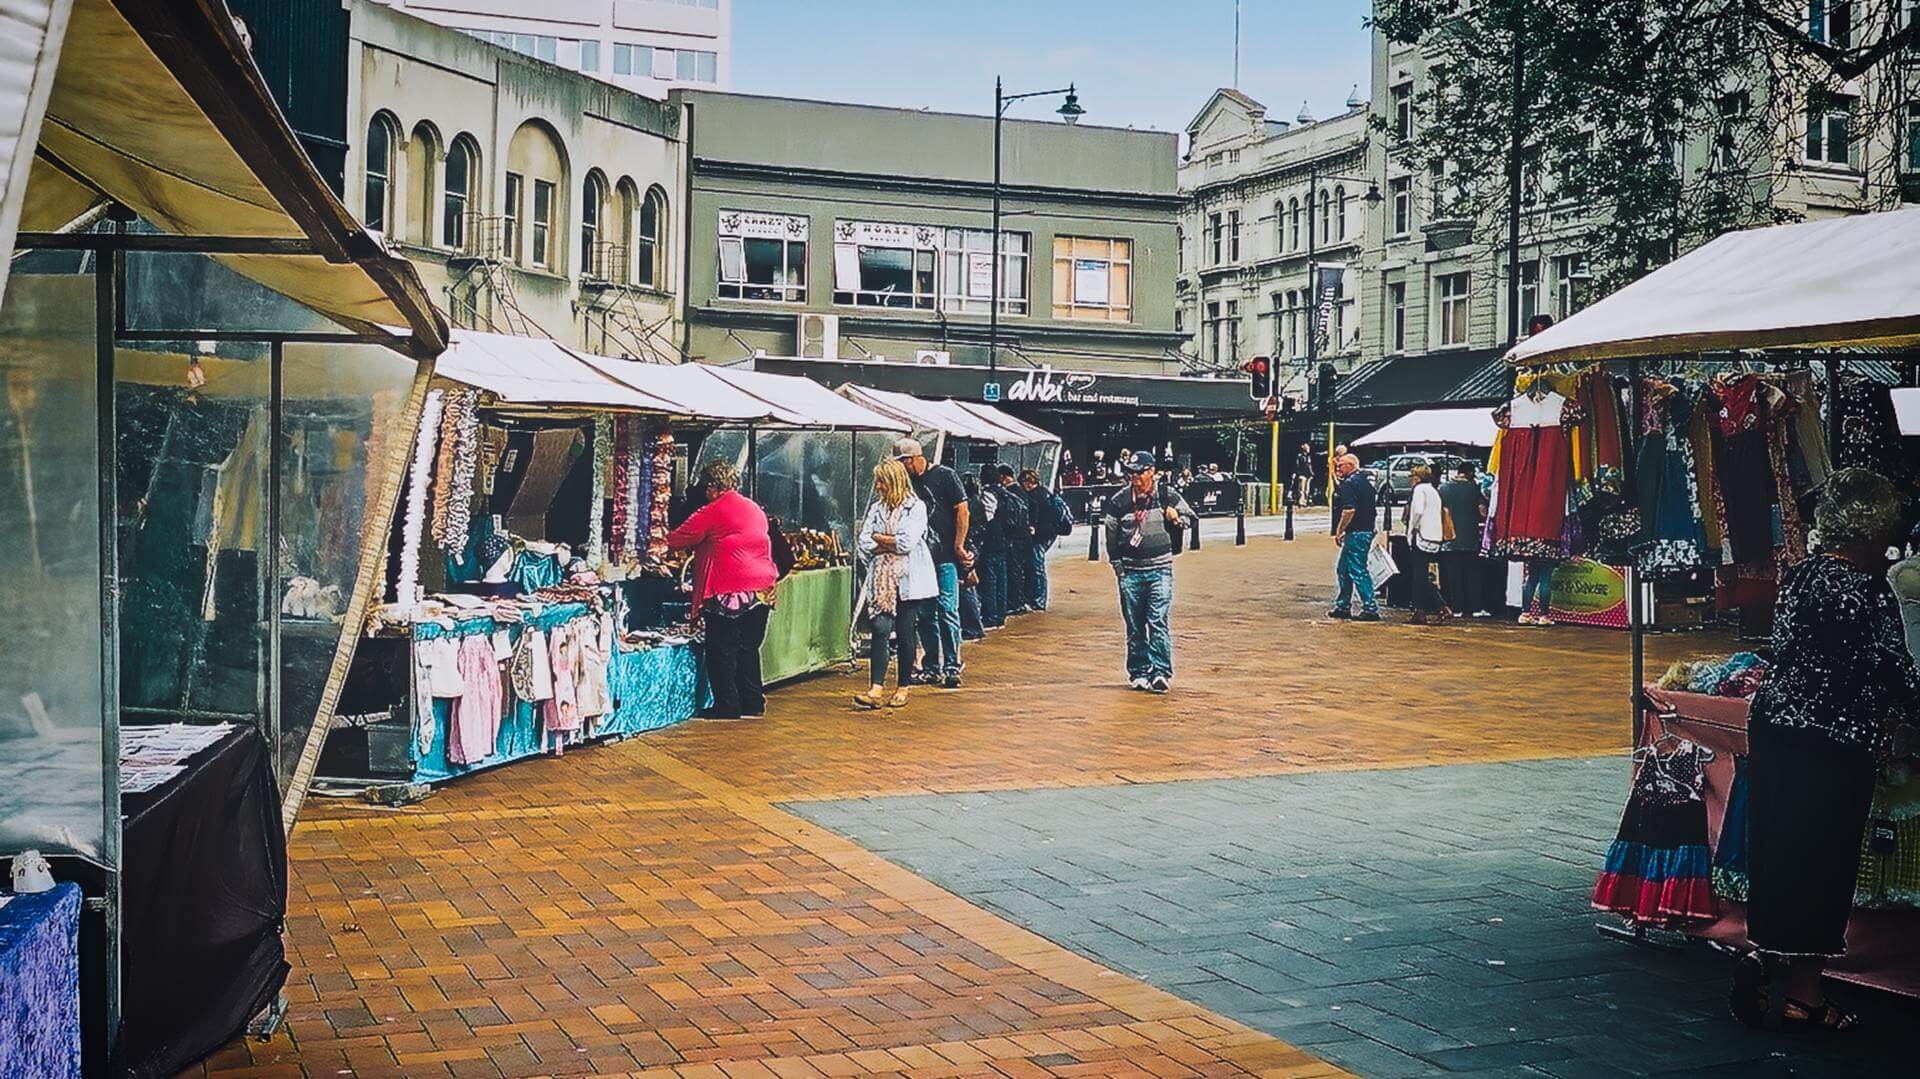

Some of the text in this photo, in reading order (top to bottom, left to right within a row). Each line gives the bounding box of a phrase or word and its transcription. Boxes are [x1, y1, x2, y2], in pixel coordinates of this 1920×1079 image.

[744, 216, 783, 226] CRAZY
[1008, 367, 1064, 402] alibi
[1068, 392, 1082, 402] bar
[1083, 393, 1098, 403] and
[1099, 395, 1139, 407] restaurant
